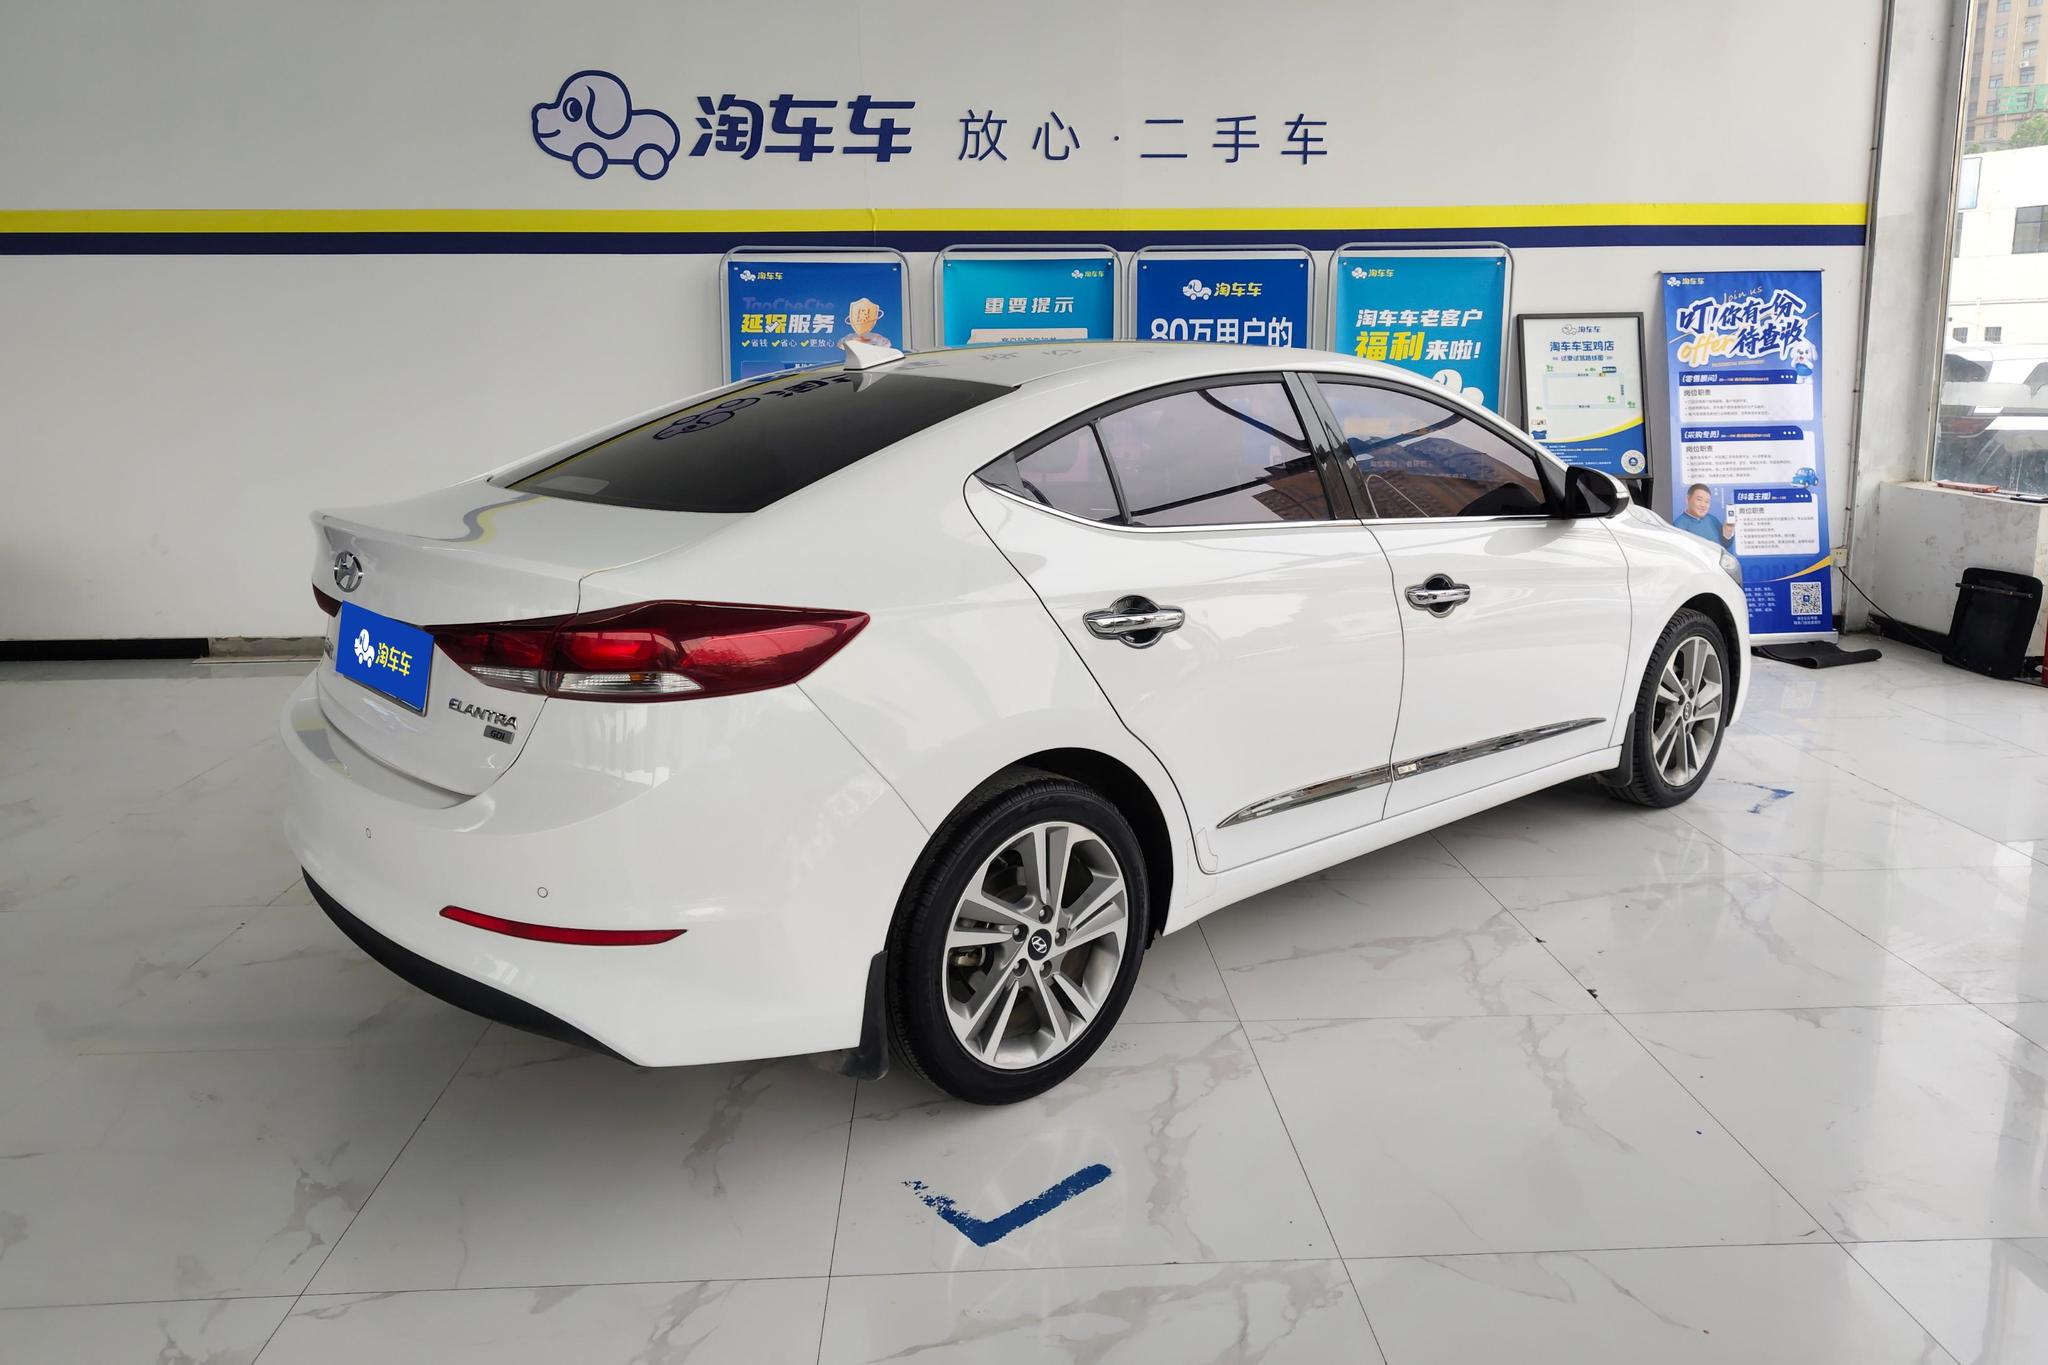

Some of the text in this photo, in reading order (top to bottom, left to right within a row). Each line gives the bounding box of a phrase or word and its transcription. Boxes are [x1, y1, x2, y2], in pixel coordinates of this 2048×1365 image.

[688, 94, 916, 162] 淘车车
[958, 109, 1328, 165] 放心·二手车
[757, 271, 784, 280] 淘车车
[1084, 270, 1105, 278] 淘车车
[1368, 268, 1395, 278] 淘车车
[1213, 281, 1263, 297] 淘车车
[1682, 277, 1705, 286] 淘车车
[985, 297, 1075, 314] 重要提示
[741, 313, 835, 334] 延保服务
[1356, 308, 1484, 327] 淘车车老客户
[1150, 316, 1293, 348] 80万用户的
[1577, 325, 1601, 333] 淘车车
[751, 339, 835, 348] 省钱 省心 更放心
[1550, 340, 1615, 352] 淘车车宝鸡店
[375, 641, 413, 677] 淘车车
[448, 697, 518, 731] ELANTRA
[490, 729, 507, 742] GDI
